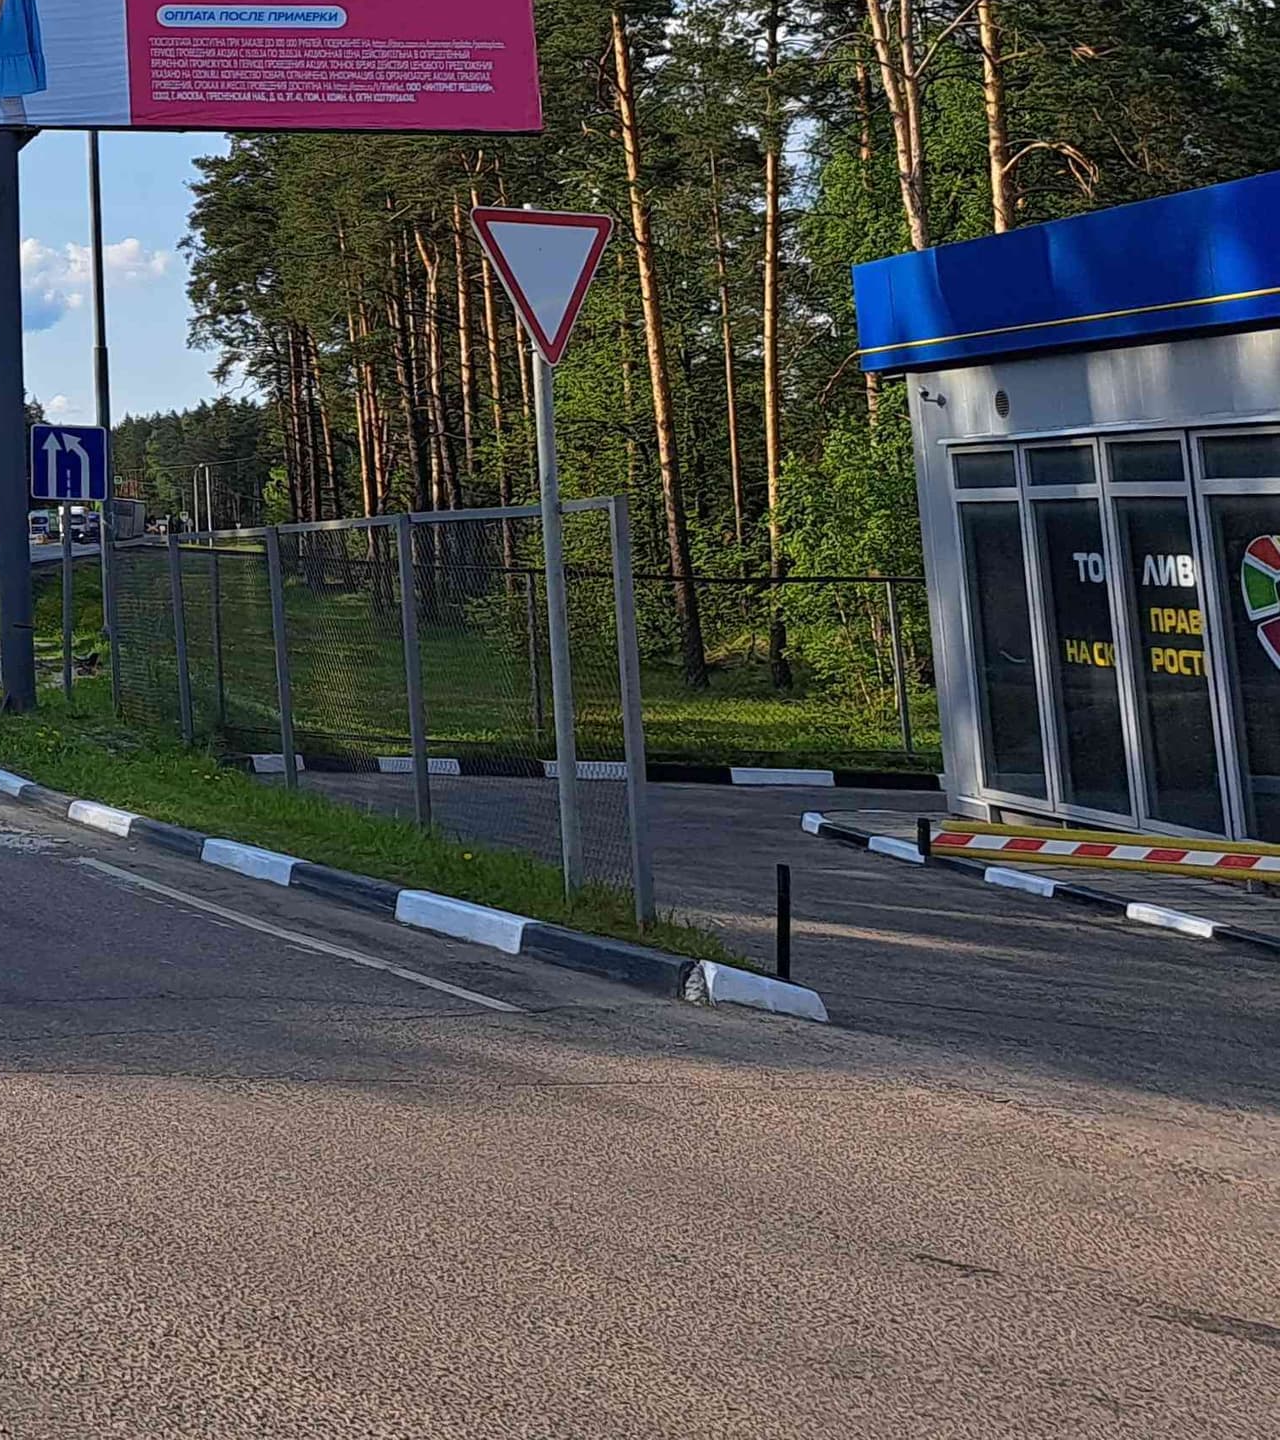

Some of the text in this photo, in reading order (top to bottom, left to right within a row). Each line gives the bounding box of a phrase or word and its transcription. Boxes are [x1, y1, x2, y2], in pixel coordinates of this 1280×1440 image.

[164, 10, 339, 23] ОПЛАТА ПОСЛЕ ПРИМЕРКИ
